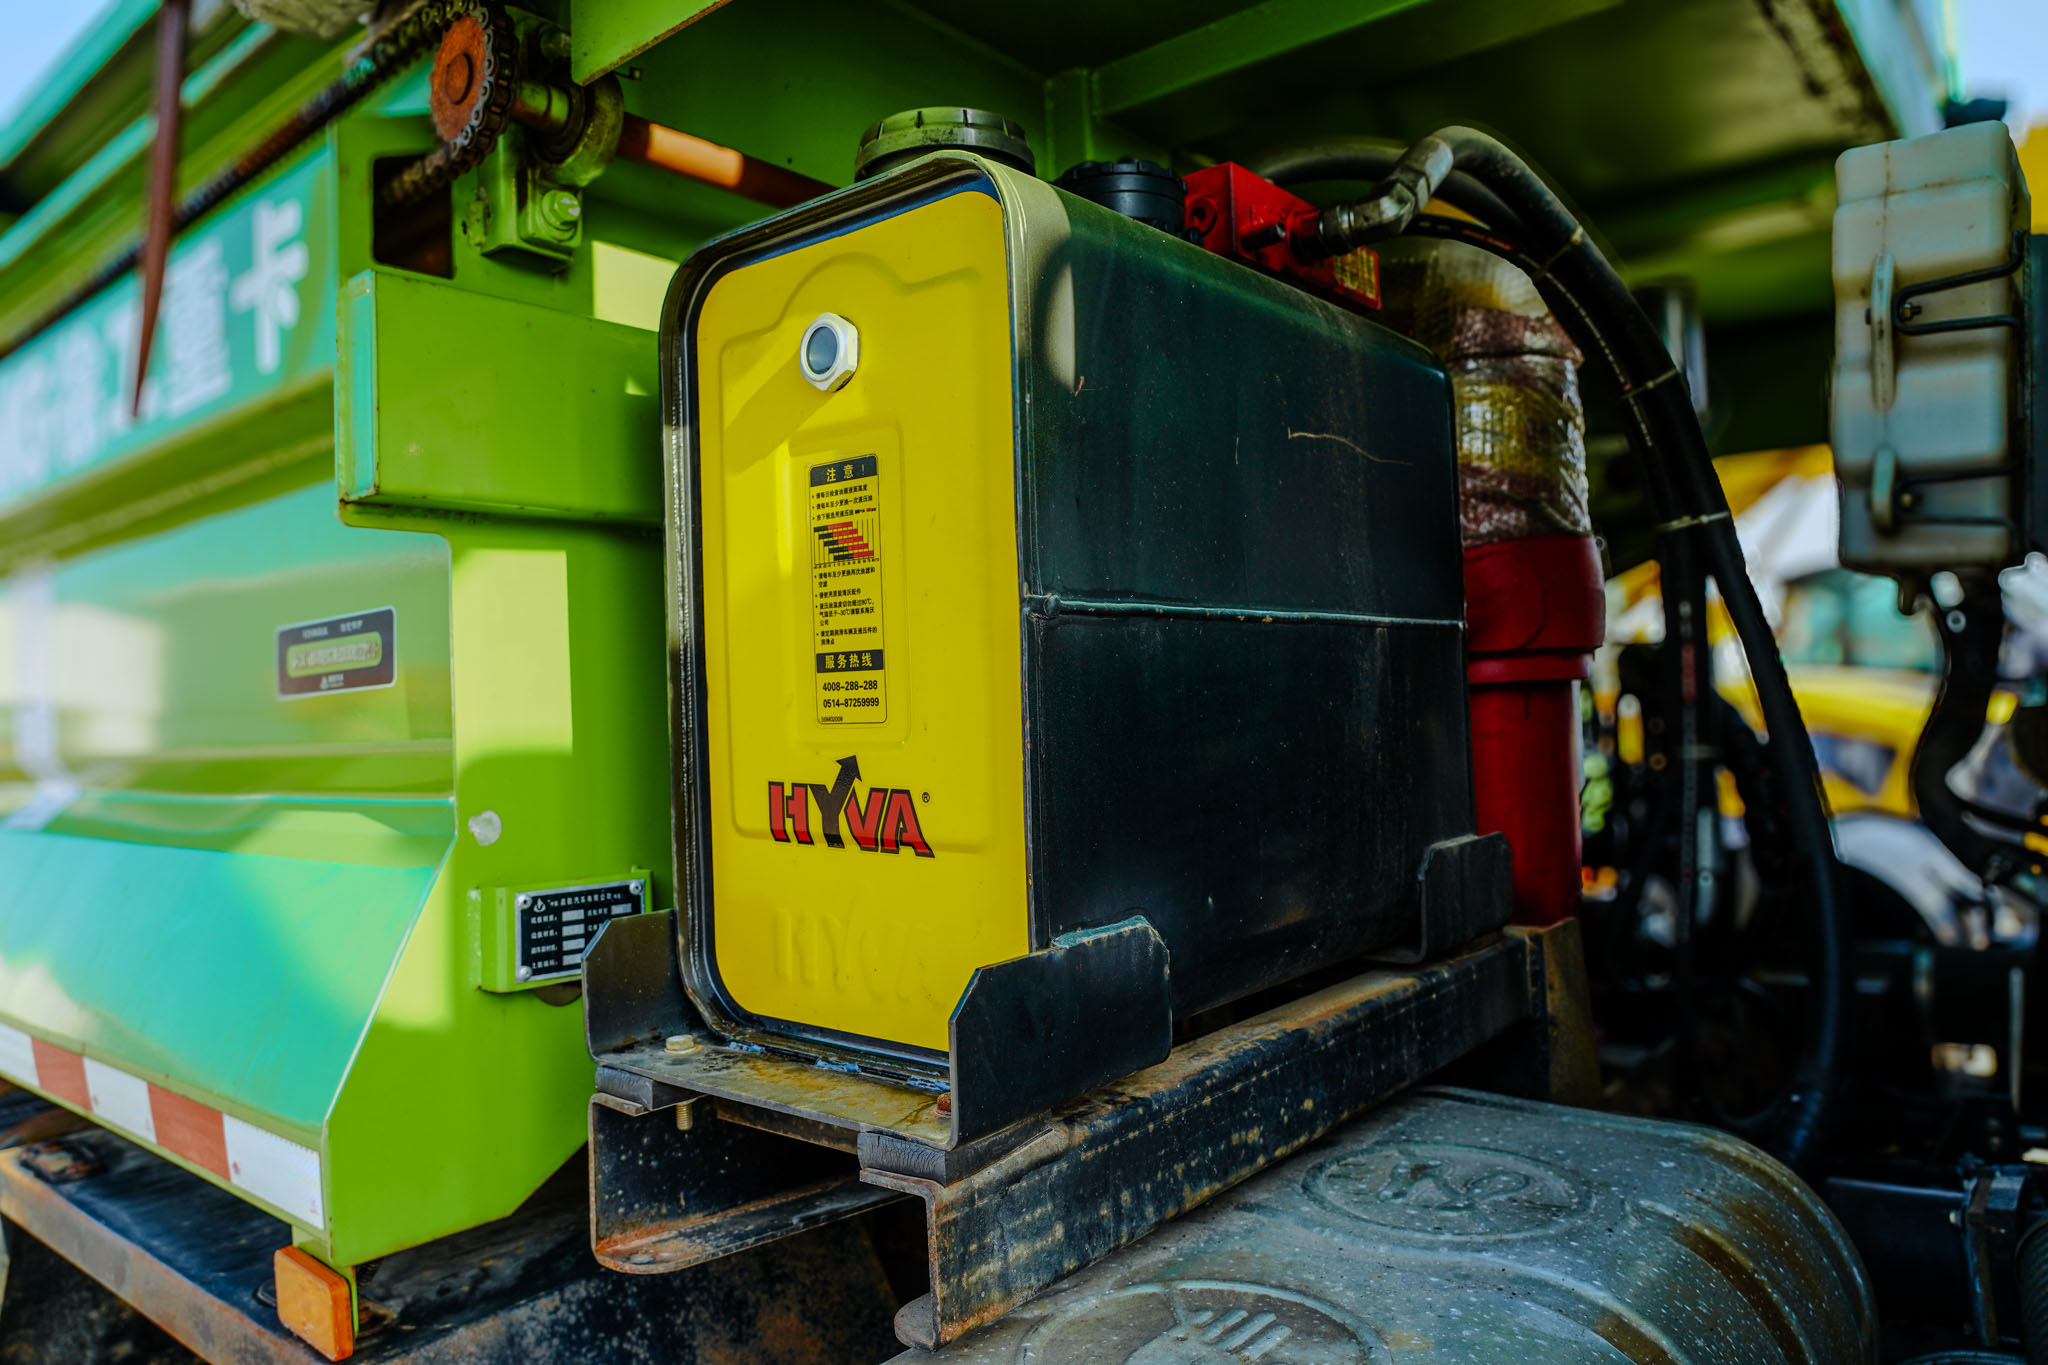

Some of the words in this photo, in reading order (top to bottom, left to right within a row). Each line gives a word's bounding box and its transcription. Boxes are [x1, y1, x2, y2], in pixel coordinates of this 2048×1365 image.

[825, 652, 873, 669] 服务热线
[822, 680, 878, 691] 4008-288-288
[823, 697, 880, 708] 0514-87259999
[768, 754, 936, 859] HYVA
